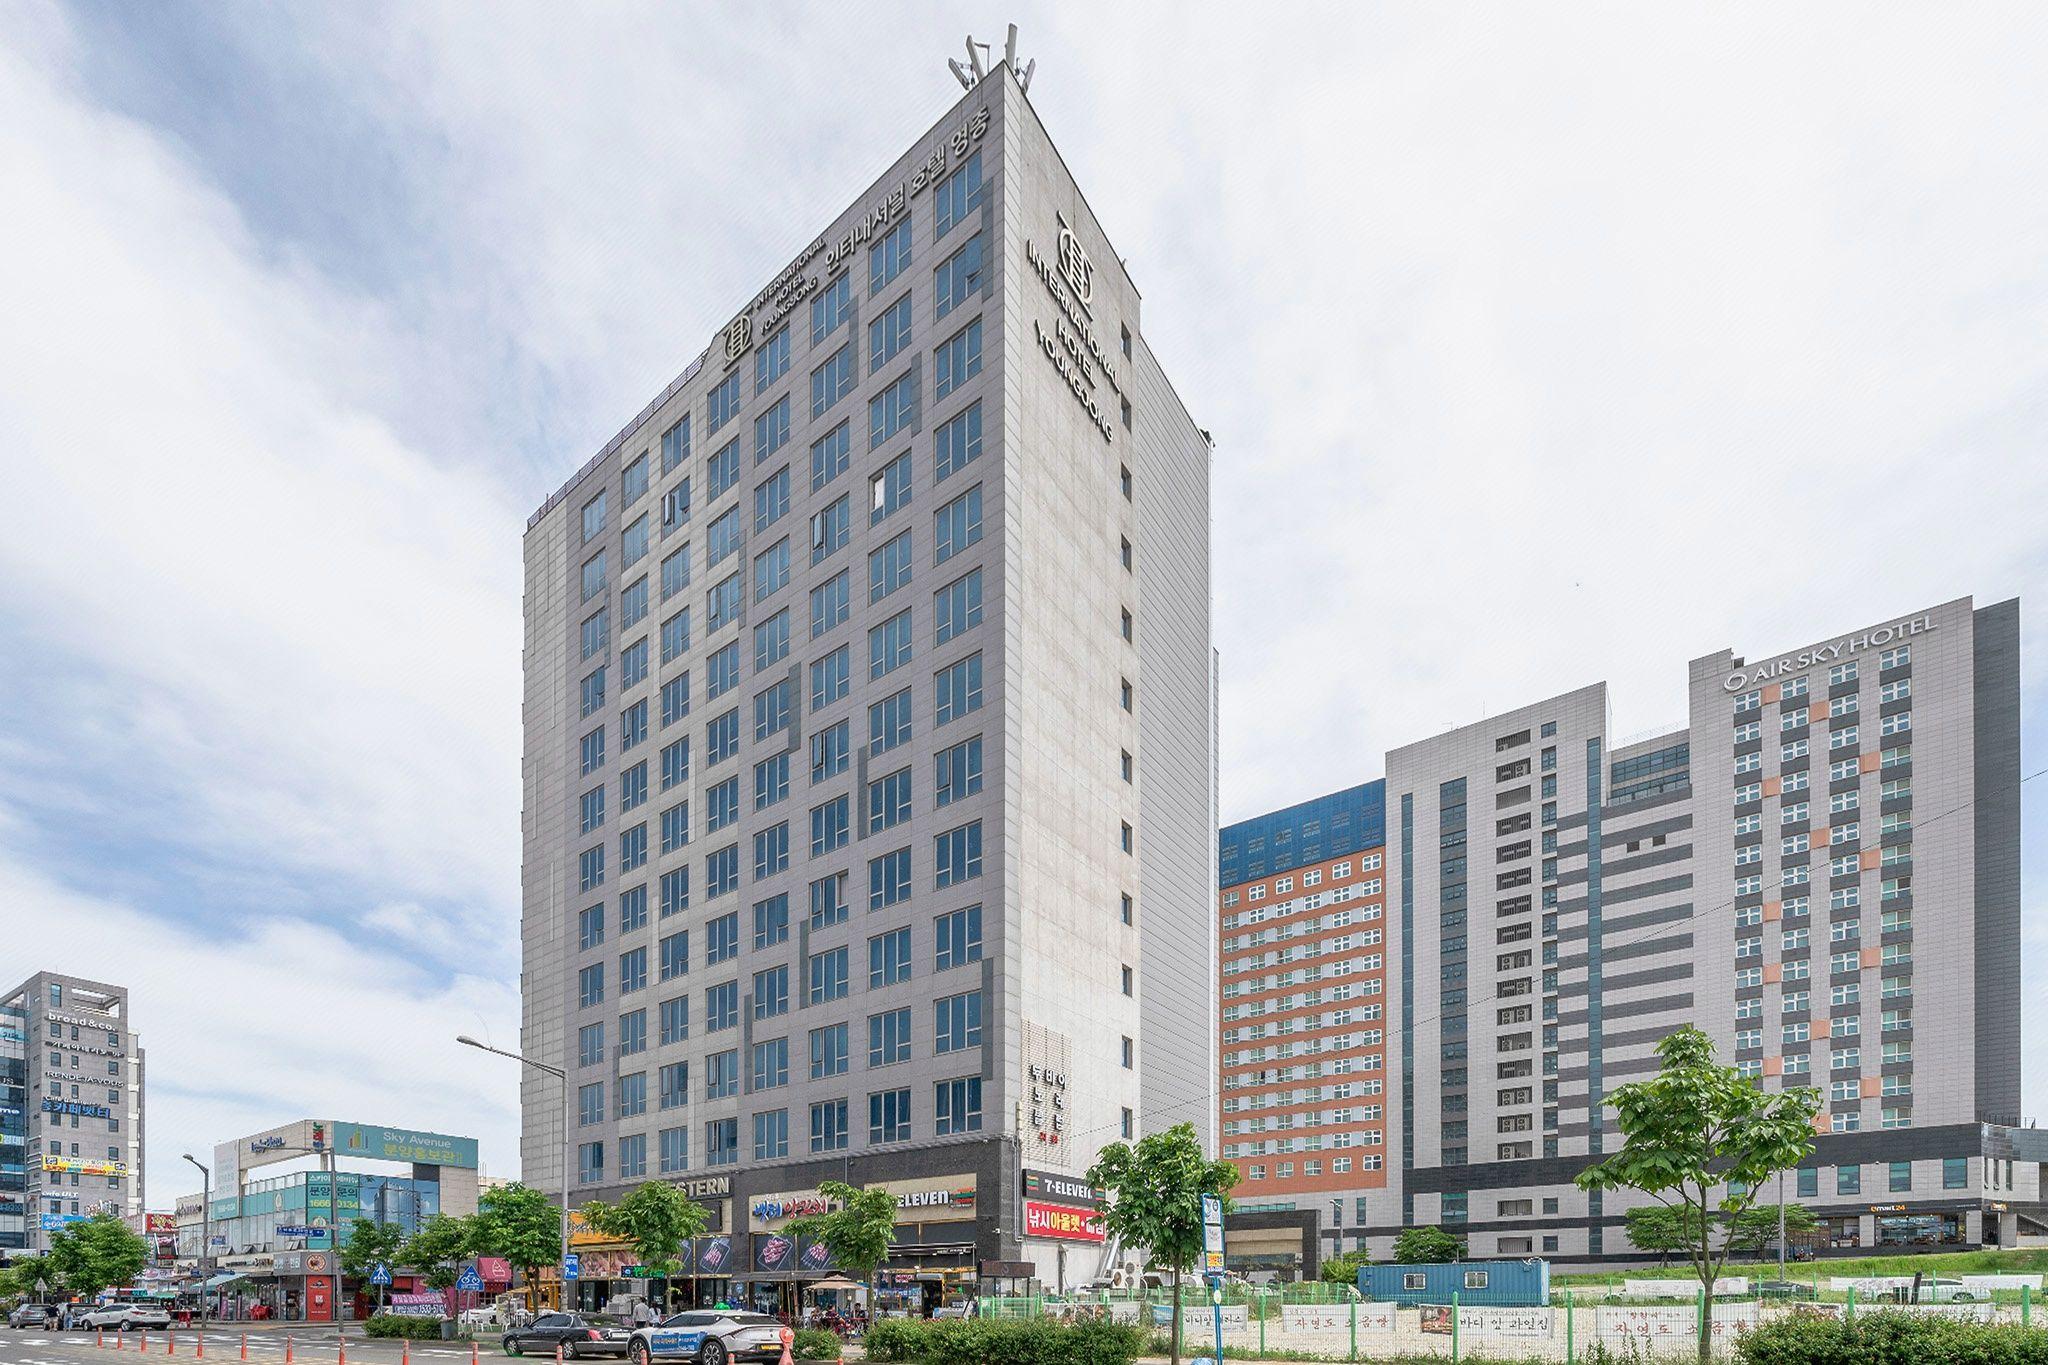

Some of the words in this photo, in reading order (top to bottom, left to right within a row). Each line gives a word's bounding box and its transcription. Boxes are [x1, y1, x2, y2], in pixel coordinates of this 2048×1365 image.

[824, 181, 905, 275] 인터내셔널
[910, 143, 946, 199] 호텔
[950, 104, 990, 157] 영종
[754, 237, 826, 310] INTERNATIONAL
[758, 276, 818, 335] YOUNGJONG
[773, 272, 804, 304] HOTEL
[1027, 239, 1120, 393] INTERNATIONAL
[1035, 319, 1113, 443] YOUNGJONG
[1056, 318, 1096, 389] HOTEL
[1752, 659, 1793, 684] AIR
[1797, 641, 1845, 669] SKY
[1849, 615, 1938, 653] HOTEL
[383, 1132, 406, 1144] Sky
[409, 1134, 452, 1147] Avenue
[673, 1177, 730, 1197] STERN
